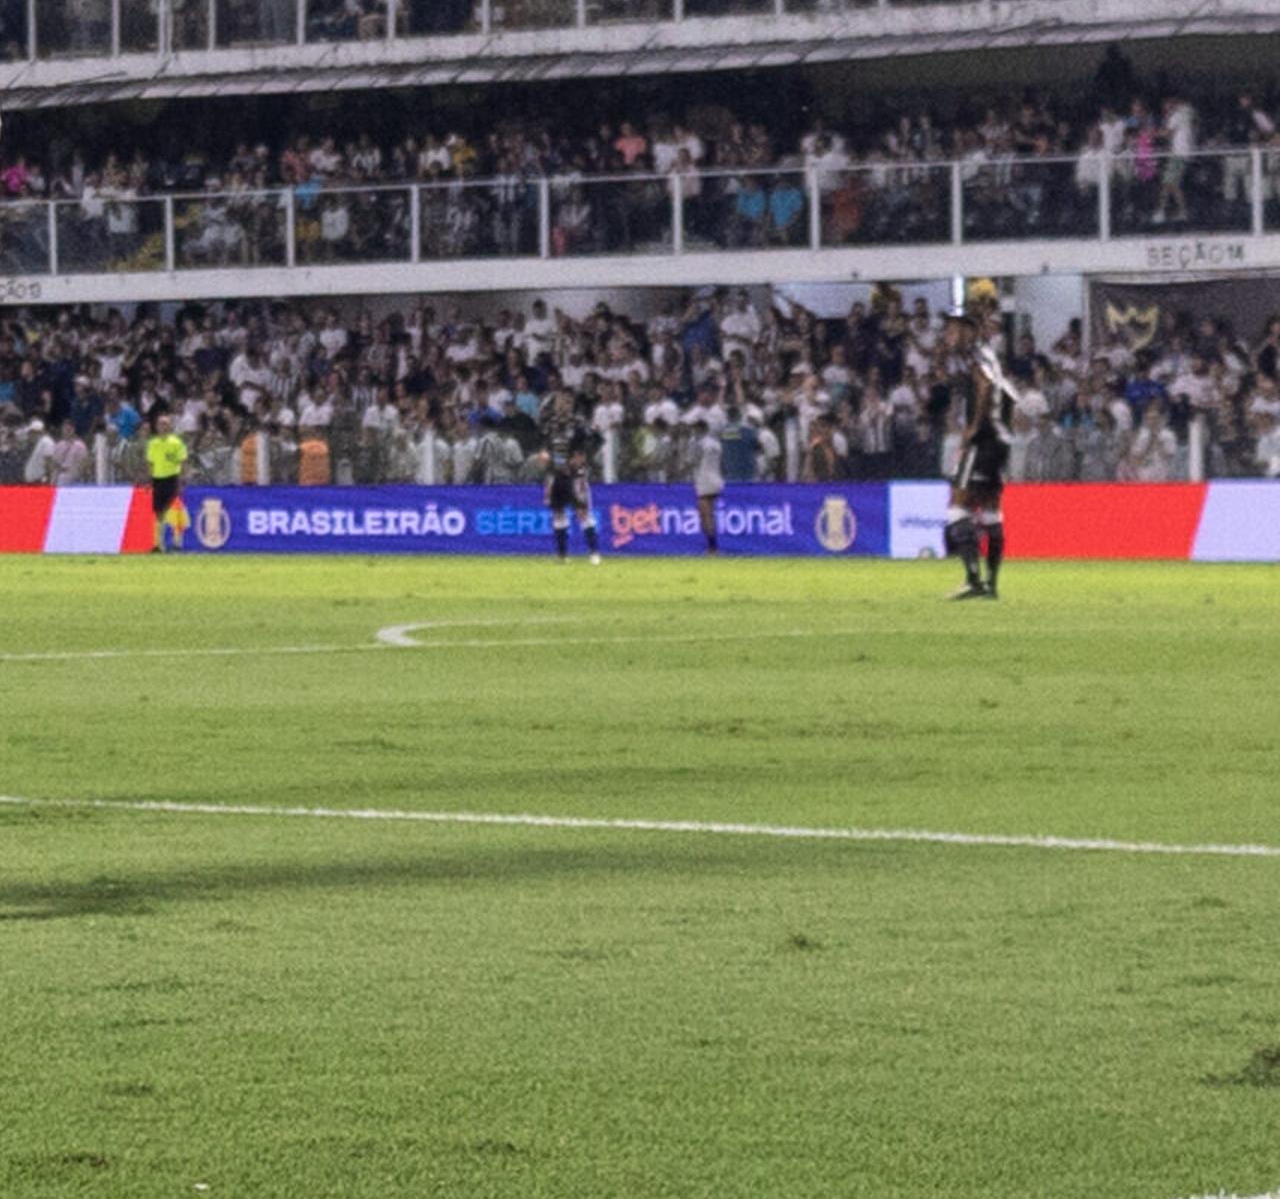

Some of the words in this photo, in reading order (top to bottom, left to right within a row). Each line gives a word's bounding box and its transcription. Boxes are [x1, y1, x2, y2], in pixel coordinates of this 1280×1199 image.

[248, 504, 466, 536] BRASILEIRÃO
[475, 505, 572, 536] SÉRI
[611, 503, 793, 536] betnaional
